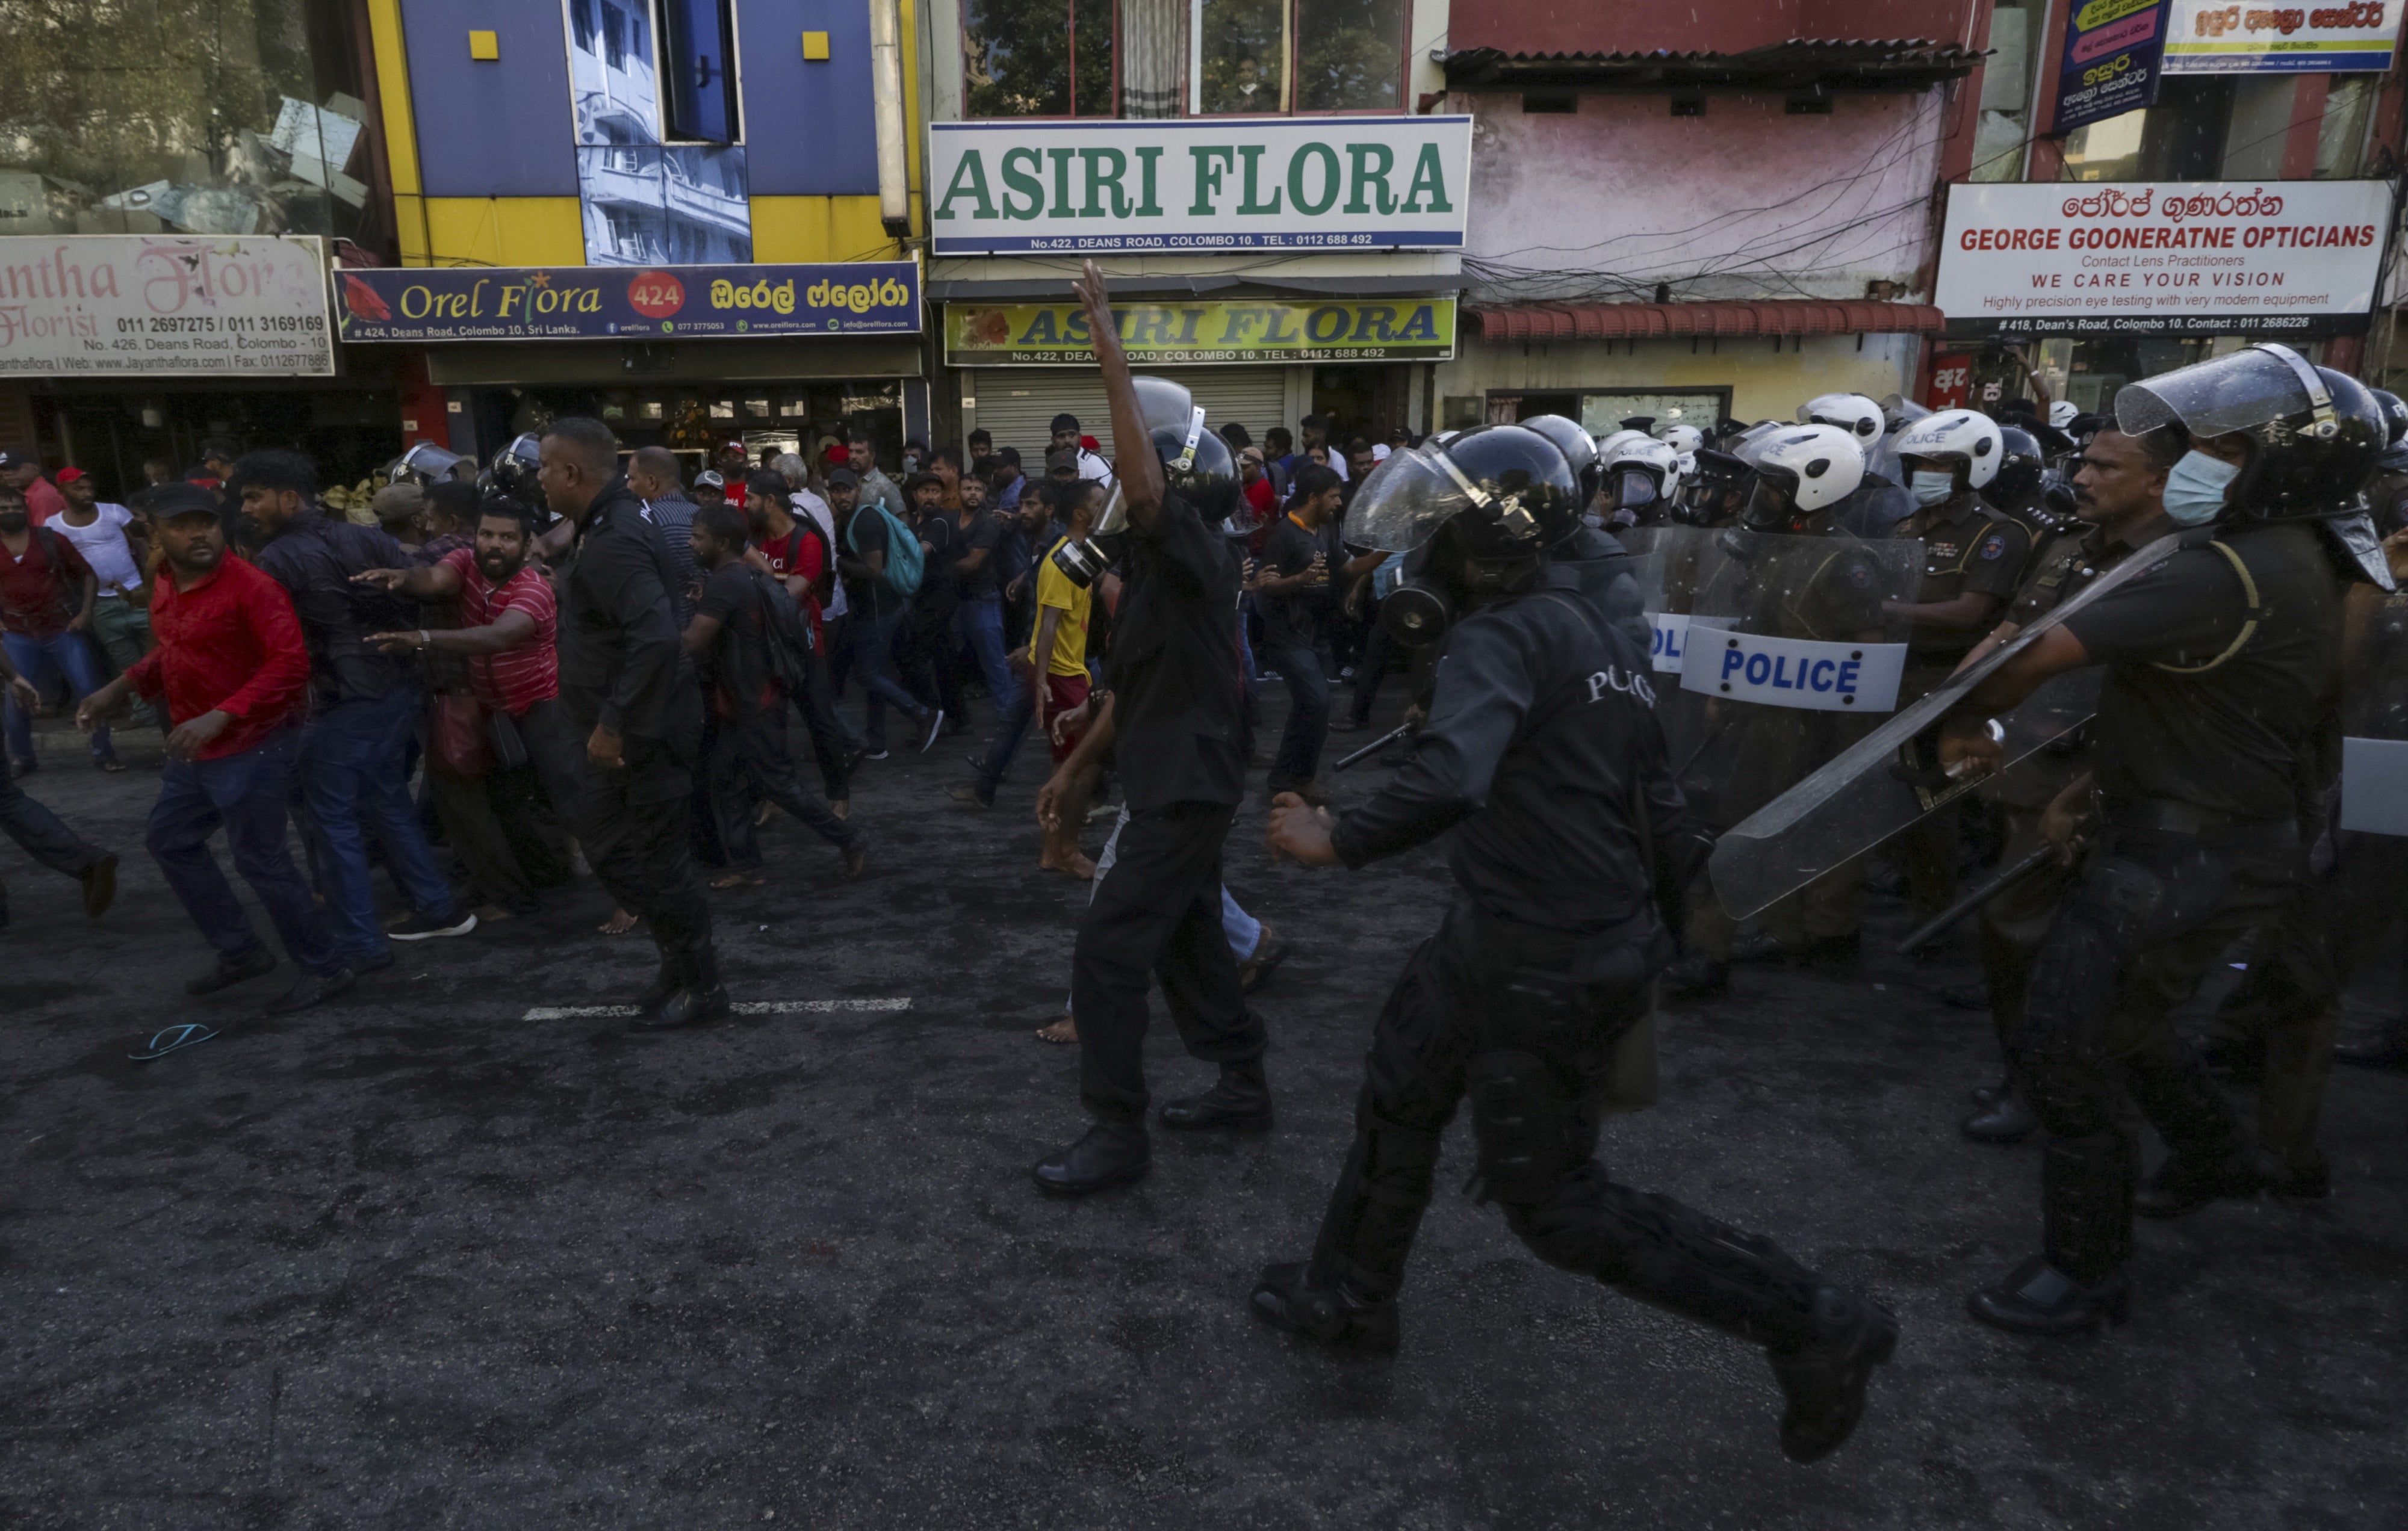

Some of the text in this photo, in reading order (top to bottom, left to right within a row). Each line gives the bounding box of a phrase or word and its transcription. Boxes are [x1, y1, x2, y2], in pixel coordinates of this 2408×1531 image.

[934, 142, 1453, 220] ASIRI FLORA
[2062, 187, 2283, 223] ජෝර්ජ් ගුණරත්න
[1031, 239, 1075, 250] No.422,
[1078, 237, 1122, 248] DEANS
[1126, 236, 1166, 247] ROAD,
[1169, 235, 1234, 246] COLOMBO
[1238, 235, 1255, 246] 10.
[1262, 235, 1285, 245] TEL
[1296, 235, 1323, 245] 0112
[1326, 234, 1348, 245] 688
[1350, 234, 1373, 244] 492
[1960, 224, 2375, 250] GEORGE GOONERATNE OPTICIANS
[2082, 253, 2245, 267] Contact Lens Practitioners
[2032, 272, 2285, 288] WE CARE YOUR VISION
[400, 276, 603, 324] Orel Flora
[634, 285, 679, 306] 424
[1984, 292, 2330, 311] Highly precision eye testing with very modern equipment
[117, 316, 324, 333] 011 2697275 / 011 3169169
[354, 324, 580, 338] # 424, Deans Road, Colombo 10, Sri Lanka.
[693, 322, 725, 330] 3775053
[1218, 306, 1439, 344] FLORA
[1998, 320, 2008, 331] #
[2009, 320, 2032, 332] 418,
[2035, 318, 2074, 330] Dean's
[2077, 318, 2111, 331] Road,
[2114, 318, 2165, 330] Colombo
[2167, 318, 2184, 329] 10.
[2186, 318, 2232, 329] Contact
[2240, 318, 2260, 328] 011
[2261, 317, 2310, 328] 2686226
[83, 339, 107, 350] No.
[145, 338, 190, 350] Deans
[193, 338, 233, 350] Road,
[237, 337, 297, 349] Colombo
[311, 337, 327, 348] 10
[62, 357, 93, 369] Web:
[234, 354, 259, 368] Fax:
[260, 354, 328, 368] 0112677886
[1012, 352, 1061, 362] No.422,
[1065, 351, 1097, 361] DEA
[1125, 350, 1161, 362] OAD,
[1164, 350, 1237, 361] COLOMBO
[1240, 350, 1259, 360] 10.
[1263, 350, 1288, 360] TEL
[1300, 349, 1330, 359] 0112
[1334, 349, 1358, 359] 688
[1361, 348, 1385, 358] 492
[1906, 431, 1946, 444] OLICE
[1721, 649, 1861, 693] POLICE
